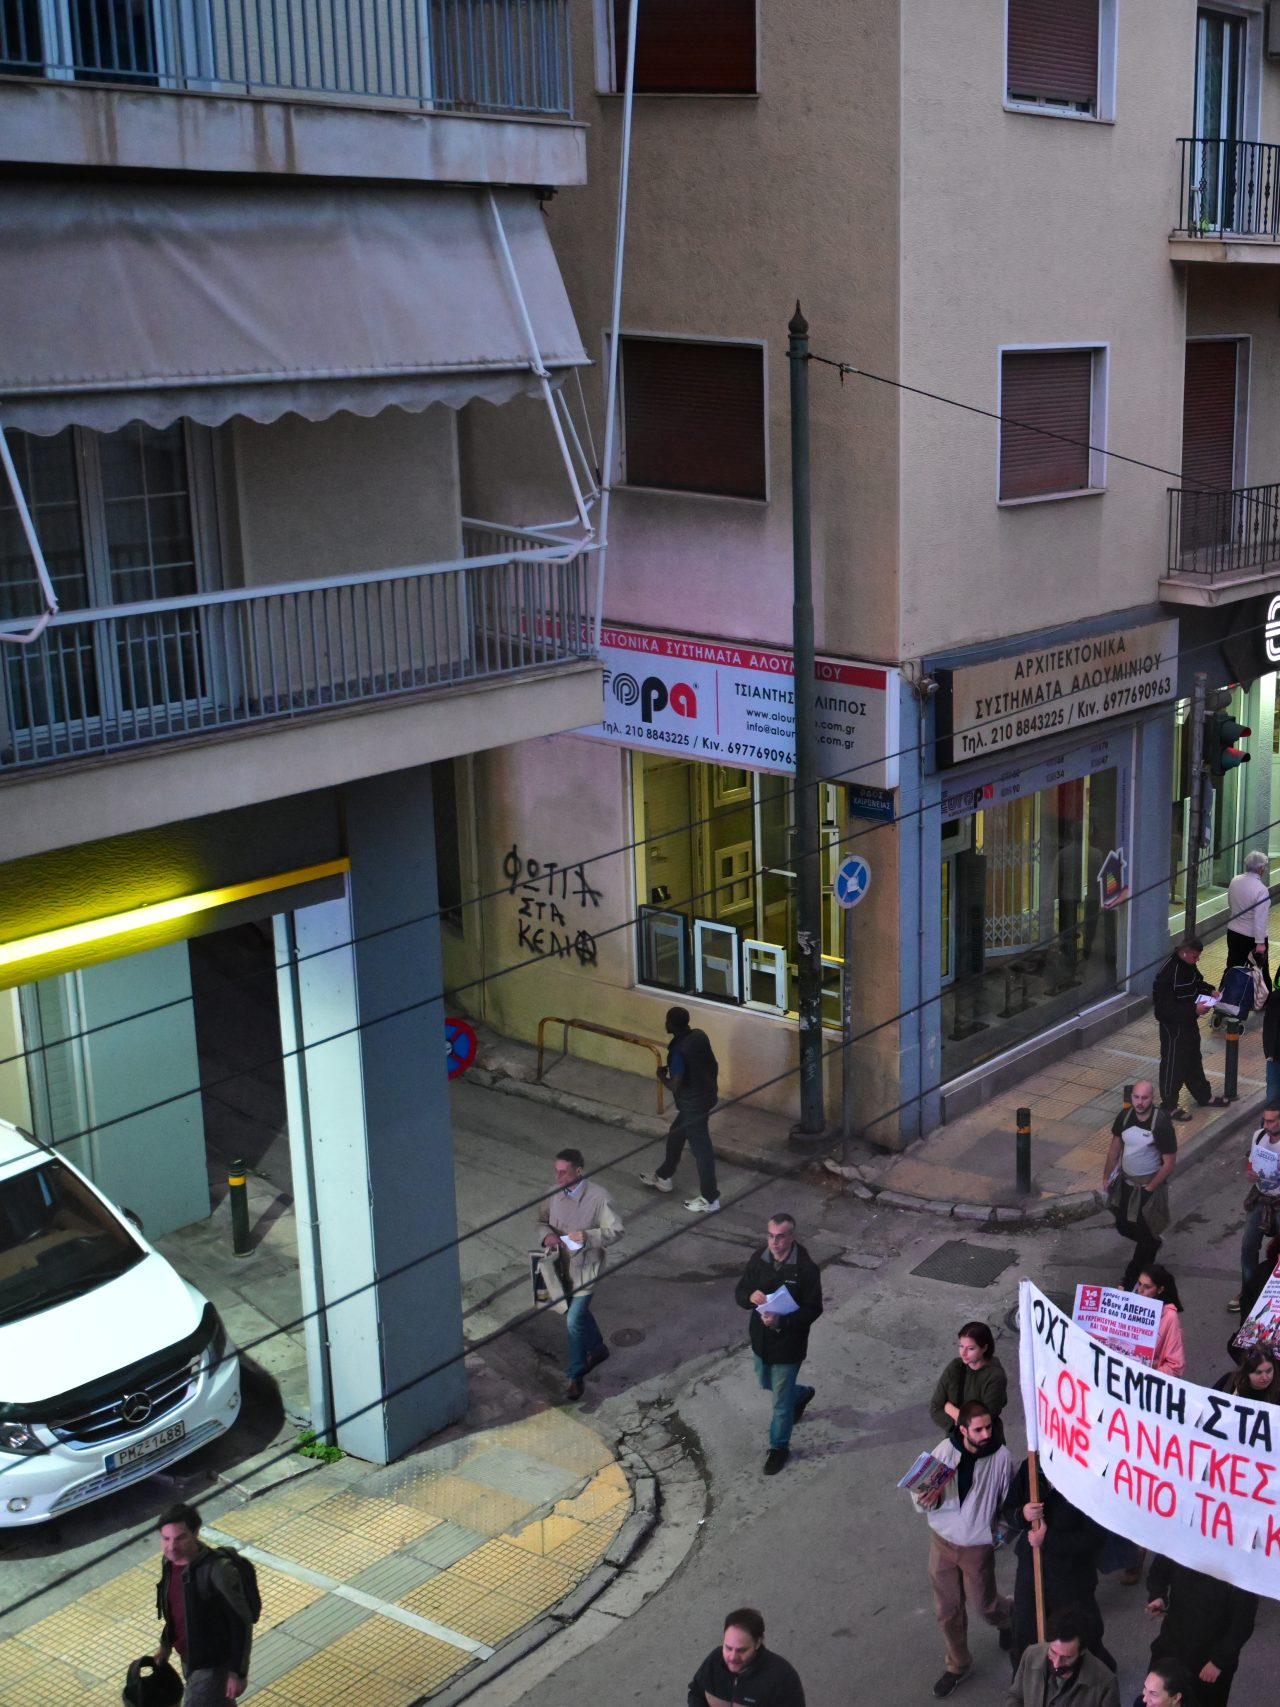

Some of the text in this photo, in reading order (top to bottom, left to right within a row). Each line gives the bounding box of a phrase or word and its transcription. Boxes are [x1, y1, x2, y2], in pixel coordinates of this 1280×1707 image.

[666, 641, 741, 665] ΣΥΣΤΗΜΑΤΑ
[1015, 636, 1126, 681] ΑΡΧΙΤΕΚΤΟΝΙΚΑ
[735, 683, 867, 716] ΤΣΙΑΝΤΗΣ ΛΙΠΠΟΣ
[975, 653, 1162, 720] ΣΥΣΤΗΜΑΤΑ ΑΛΟΥΜΙΝΙΟΥ
[625, 724, 643, 737] 210
[646, 728, 690, 746] 8843225
[962, 732, 987, 754] Τηλ.
[991, 724, 1012, 744] 210
[1016, 709, 1064, 738] 8843225
[1078, 701, 1099, 719] Κιν.
[1103, 677, 1171, 712] 6977690963
[519, 898, 565, 926] ΣΤΑ
[1123, 1304, 1156, 1319] ΑΠΕΡΓΙΑ
[1127, 1314, 1155, 1326] ΔΗΜΟΣΙΟ
[1033, 1299, 1069, 1364] ΟΧΙ
[1089, 1341, 1186, 1425] ΤΕΜΠΗ
[1202, 1395, 1273, 1453] ΣΤΑ
[1057, 1369, 1091, 1430] ΟΙ
[1107, 1407, 1277, 1506] ΑΝΑΓΚΕΣ
[1038, 1388, 1091, 1468] ΠΑΝΩ
[1113, 1459, 1177, 1518] ΑΠΟ
[1194, 1492, 1233, 1546] ΤΑ
